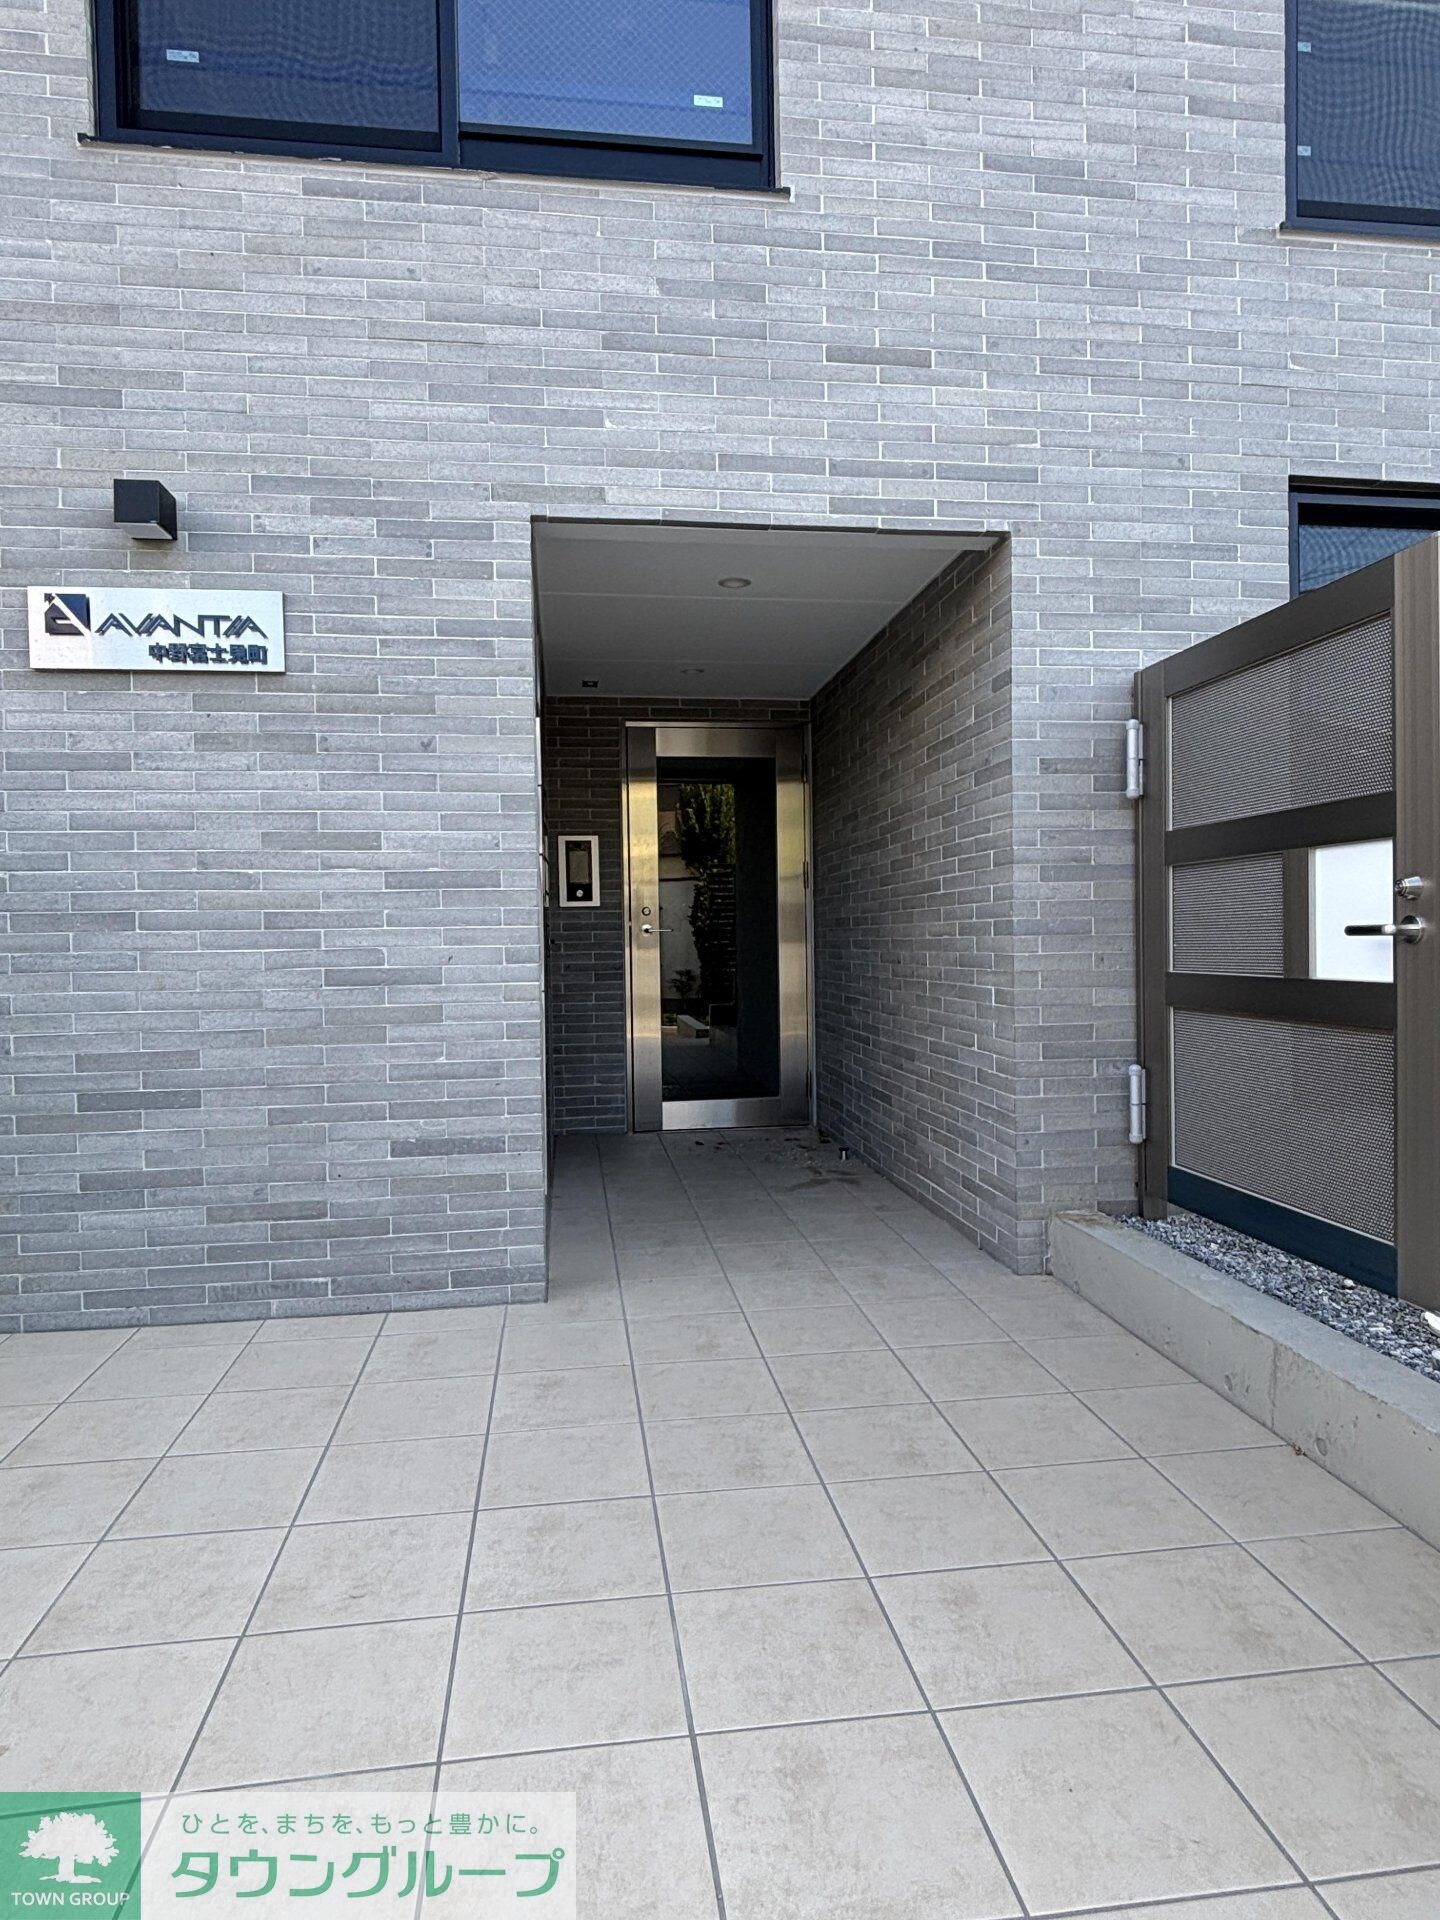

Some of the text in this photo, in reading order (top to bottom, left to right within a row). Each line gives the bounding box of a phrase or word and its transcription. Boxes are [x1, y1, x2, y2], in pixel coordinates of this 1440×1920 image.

[149, 642, 268, 665] 中野富士見町
